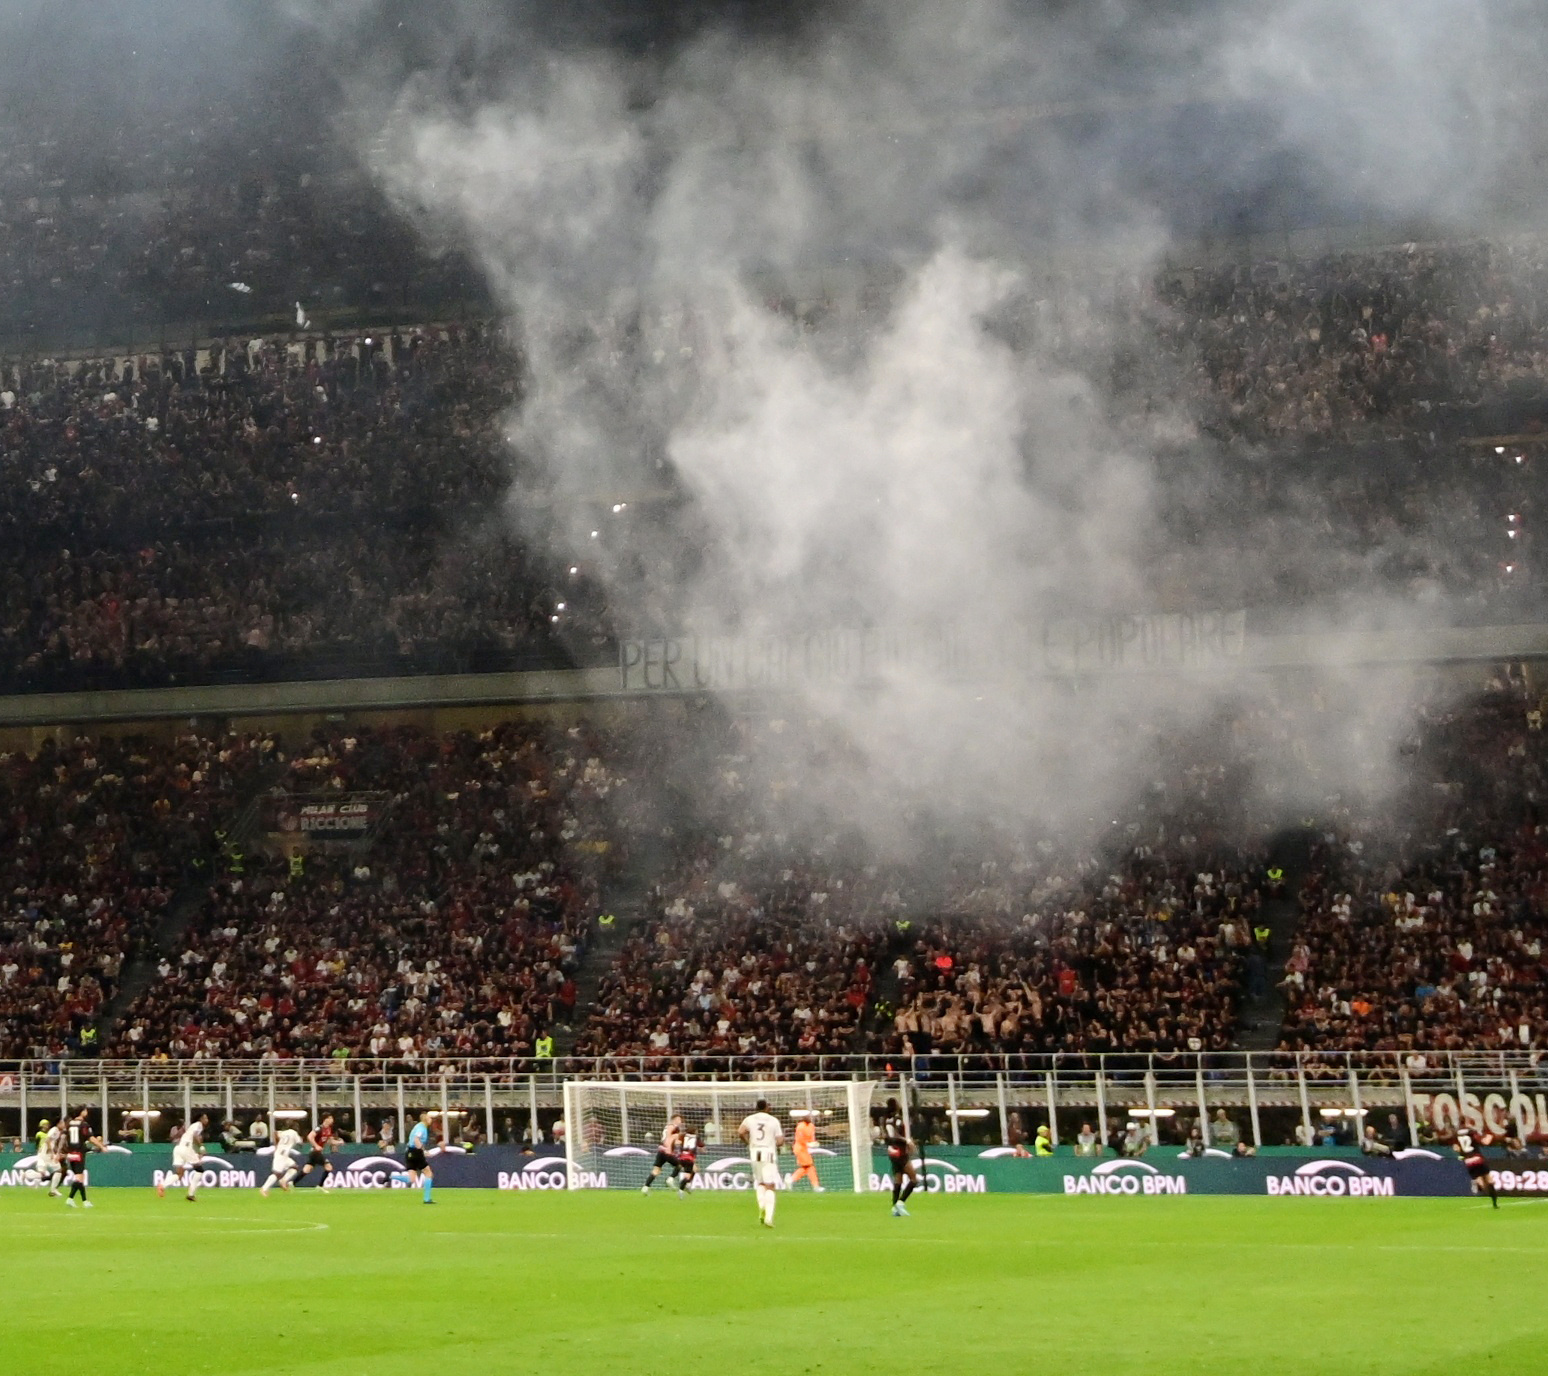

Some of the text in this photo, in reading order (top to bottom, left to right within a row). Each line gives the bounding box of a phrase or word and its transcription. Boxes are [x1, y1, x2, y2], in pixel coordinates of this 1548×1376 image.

[300, 815, 368, 831] RICCIONE
[756, 1123, 766, 1141] 3
[219, 1170, 255, 1187] BPM
[498, 1172, 566, 1190] BANCO
[943, 1174, 985, 1192] BPM
[1063, 1174, 1186, 1194] BANCO BPM
[1265, 1175, 1395, 1196] BANCO BPM
